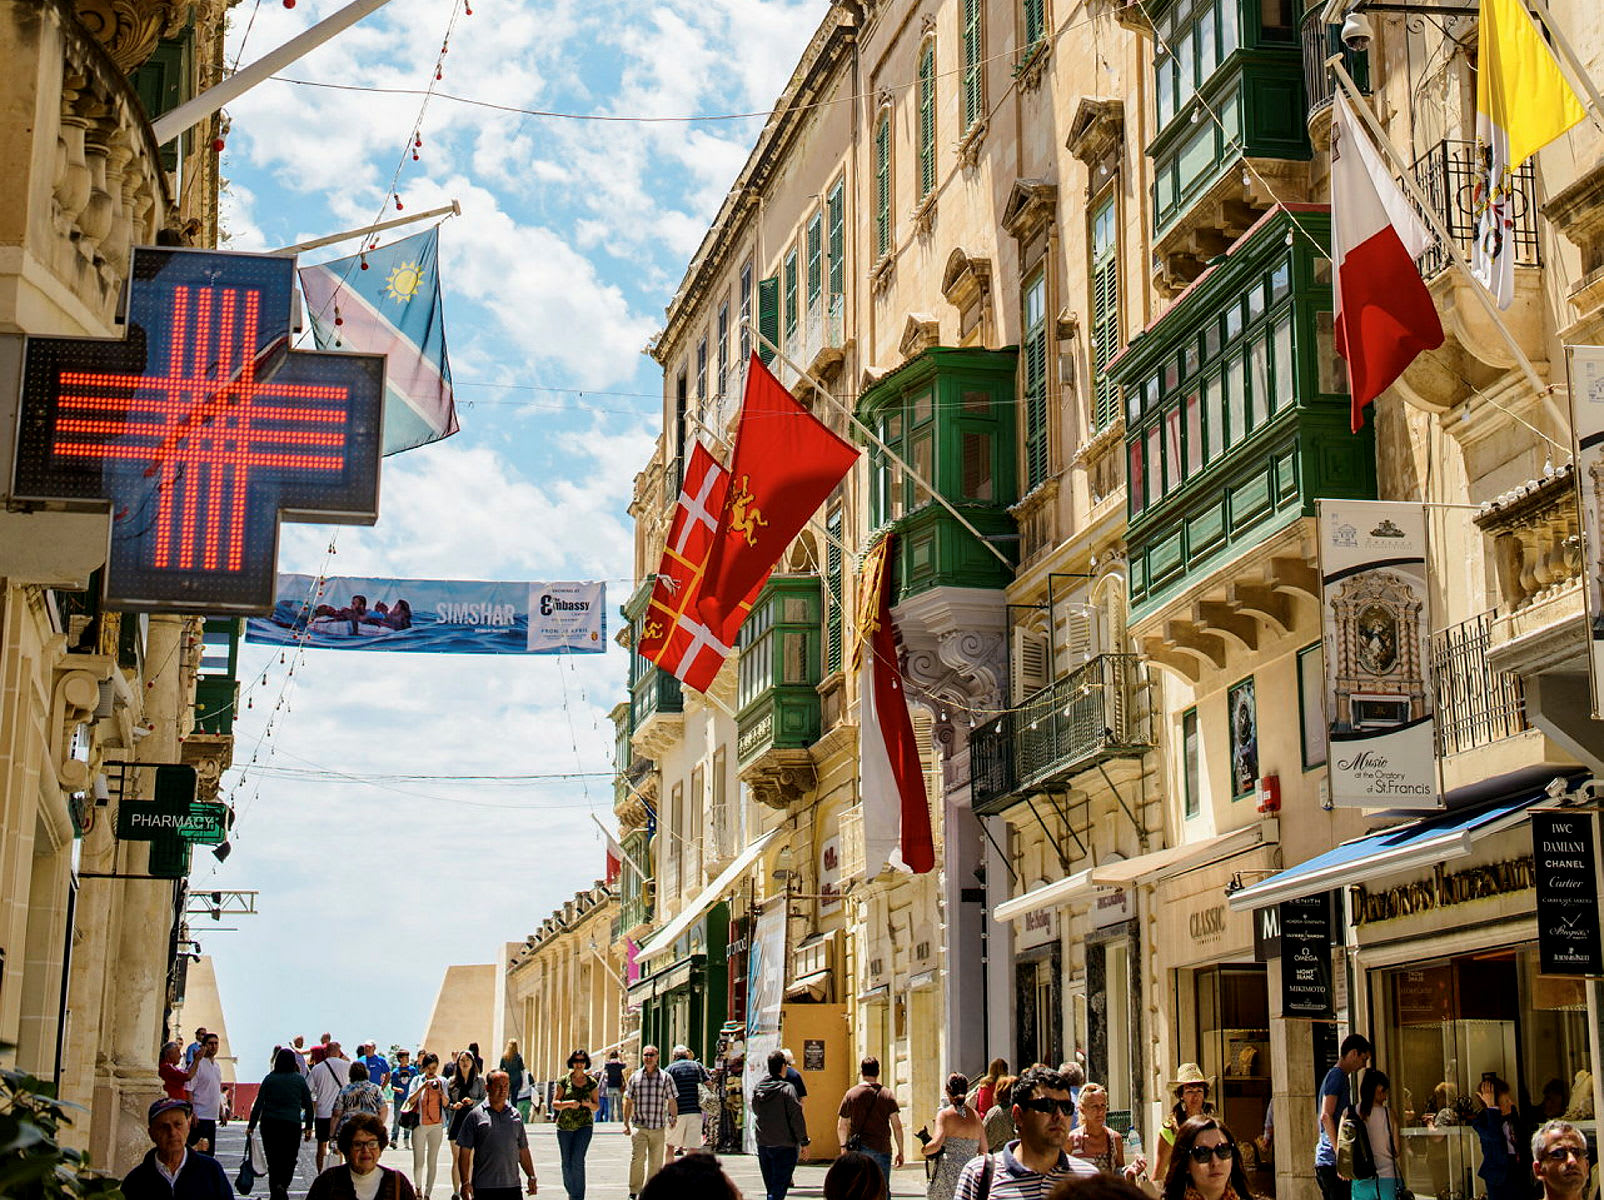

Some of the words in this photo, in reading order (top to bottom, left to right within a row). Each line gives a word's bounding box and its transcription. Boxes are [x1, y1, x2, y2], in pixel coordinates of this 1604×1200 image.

[436, 602, 515, 626] SIMSHAR
[1338, 751, 1388, 771] Music
[1363, 771, 1374, 779] the
[1374, 770, 1405, 780] Oratory
[1367, 785, 1374, 793] of
[131, 813, 215, 829] PHARMACY
[1552, 823, 1573, 833] IWC
[1543, 841, 1585, 852] DAMIANI
[1545, 860, 1585, 868] CHANEL
[1549, 876, 1584, 888] Cartier
[1190, 905, 1226, 938] CLASSIC
